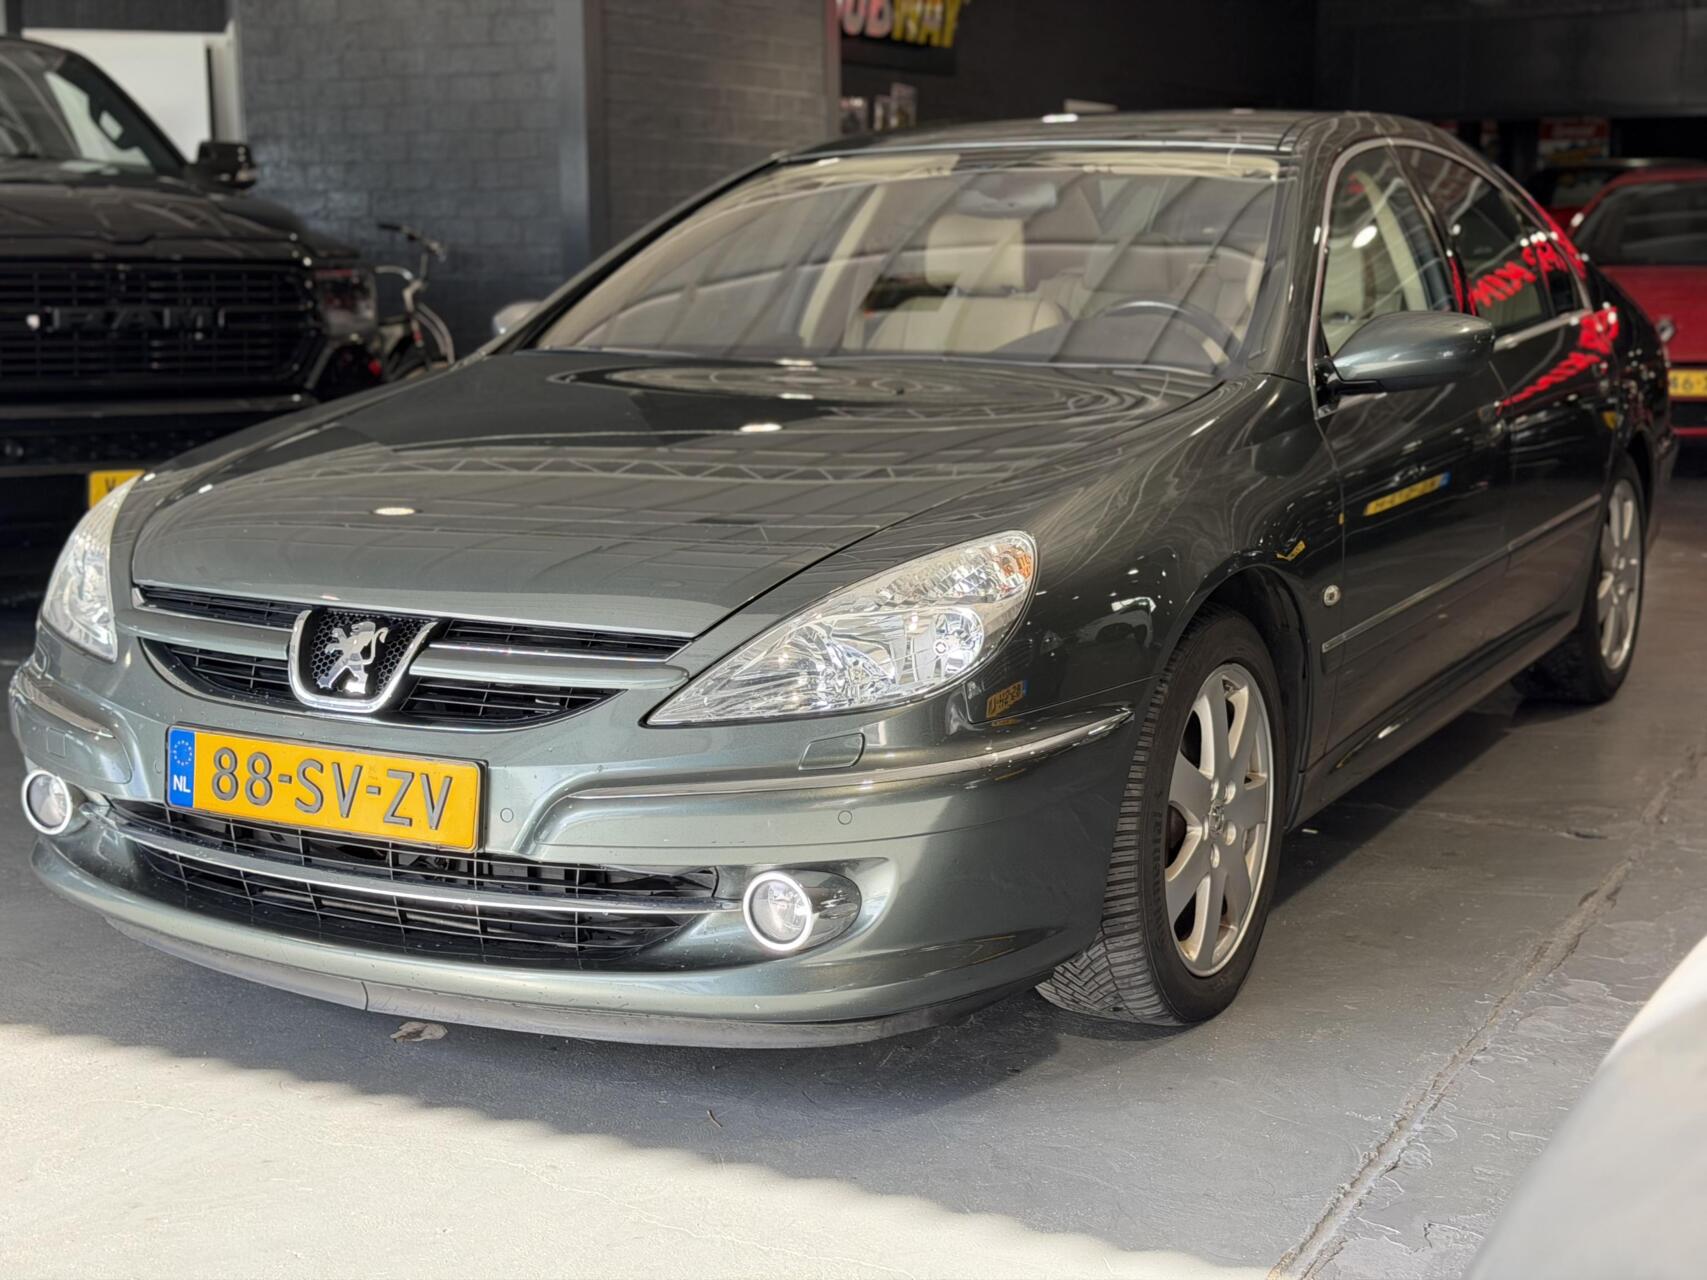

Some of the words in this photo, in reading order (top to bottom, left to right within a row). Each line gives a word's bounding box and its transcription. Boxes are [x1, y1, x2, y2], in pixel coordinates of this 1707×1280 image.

[836, 0, 964, 48] UBWAY
[173, 775, 191, 793] NL
[211, 747, 453, 830] 88-SV-ZV
